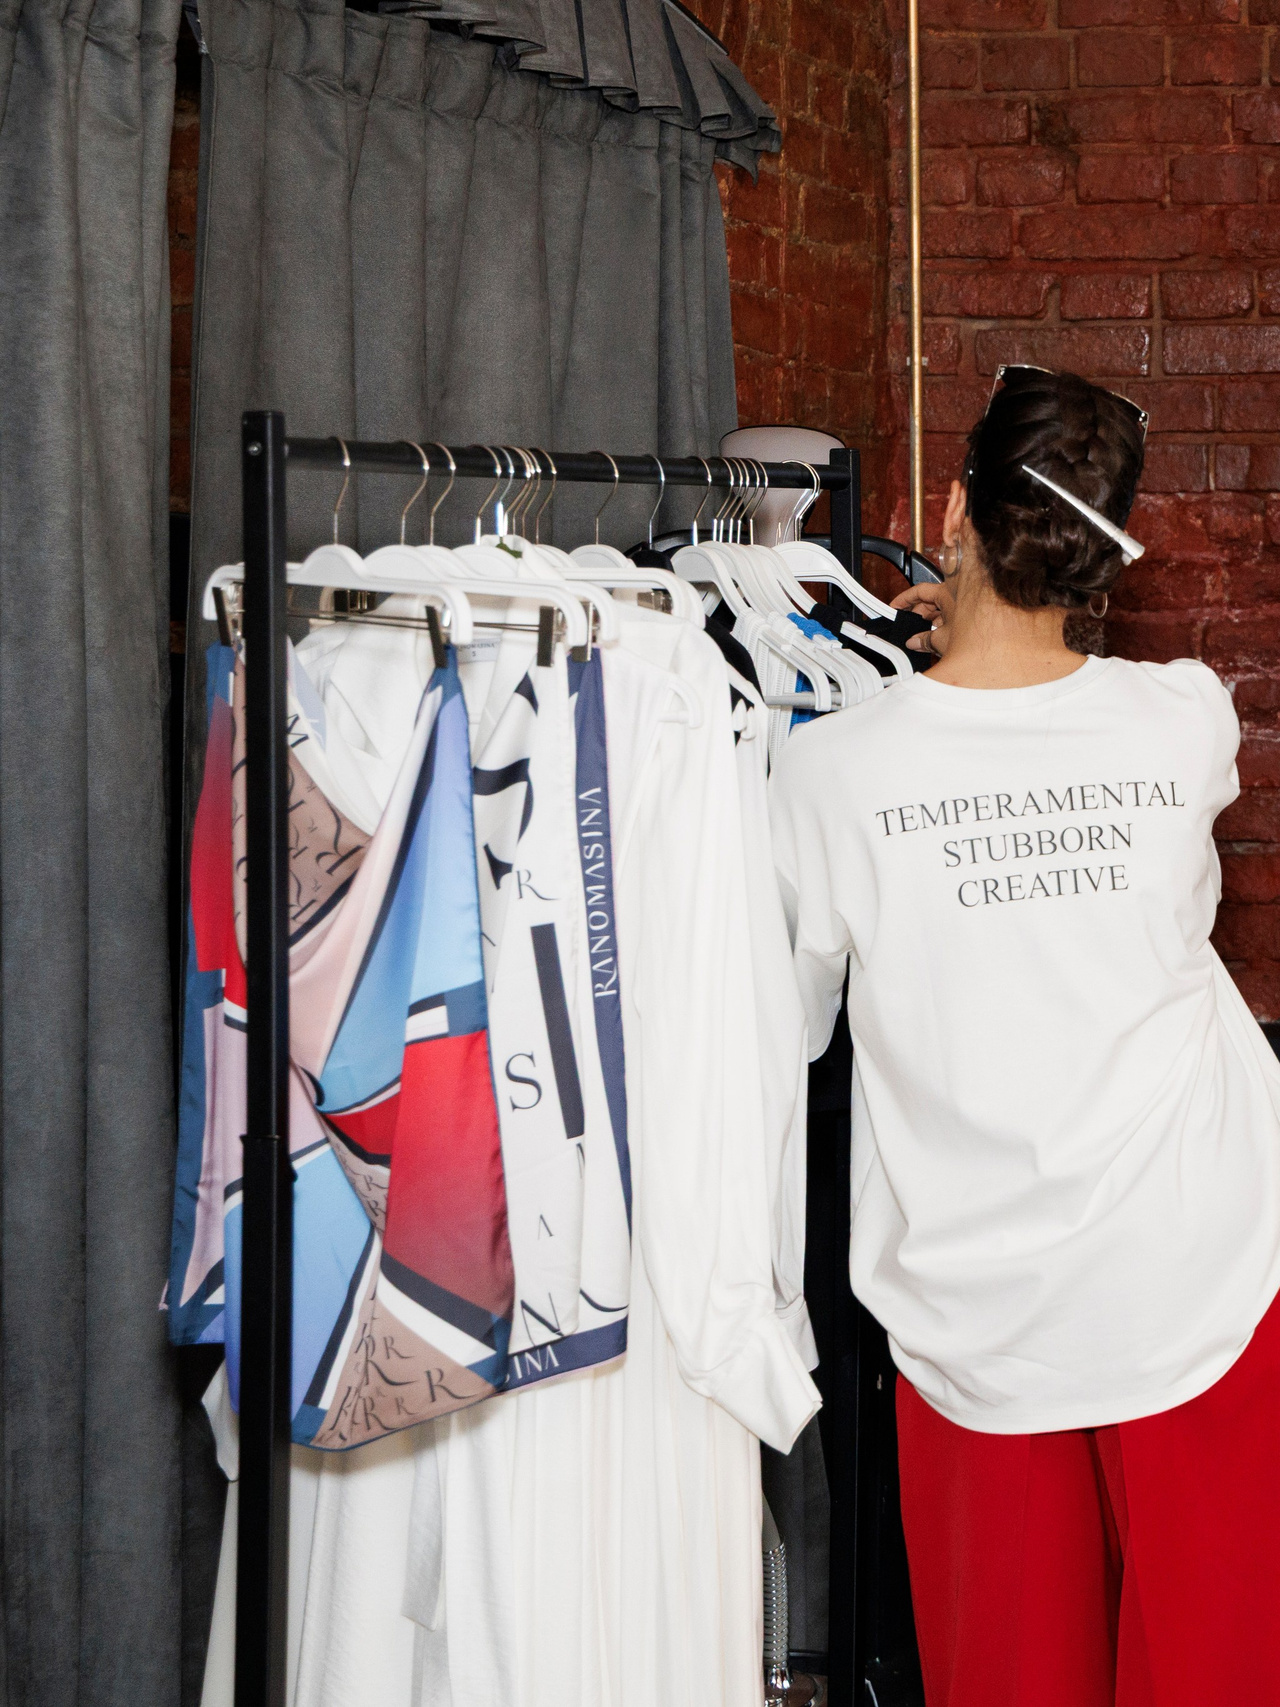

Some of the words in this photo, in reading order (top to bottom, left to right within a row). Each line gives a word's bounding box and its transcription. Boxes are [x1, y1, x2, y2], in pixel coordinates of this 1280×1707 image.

[876, 780, 1186, 837] TEMPERAMENTAL
[943, 822, 1134, 869] STUBBORN
[515, 868, 561, 901] R
[578, 787, 618, 999] RANOMASINA
[957, 864, 1130, 908] CREATIVE
[505, 1052, 543, 1112] S
[424, 1367, 480, 1403] R
